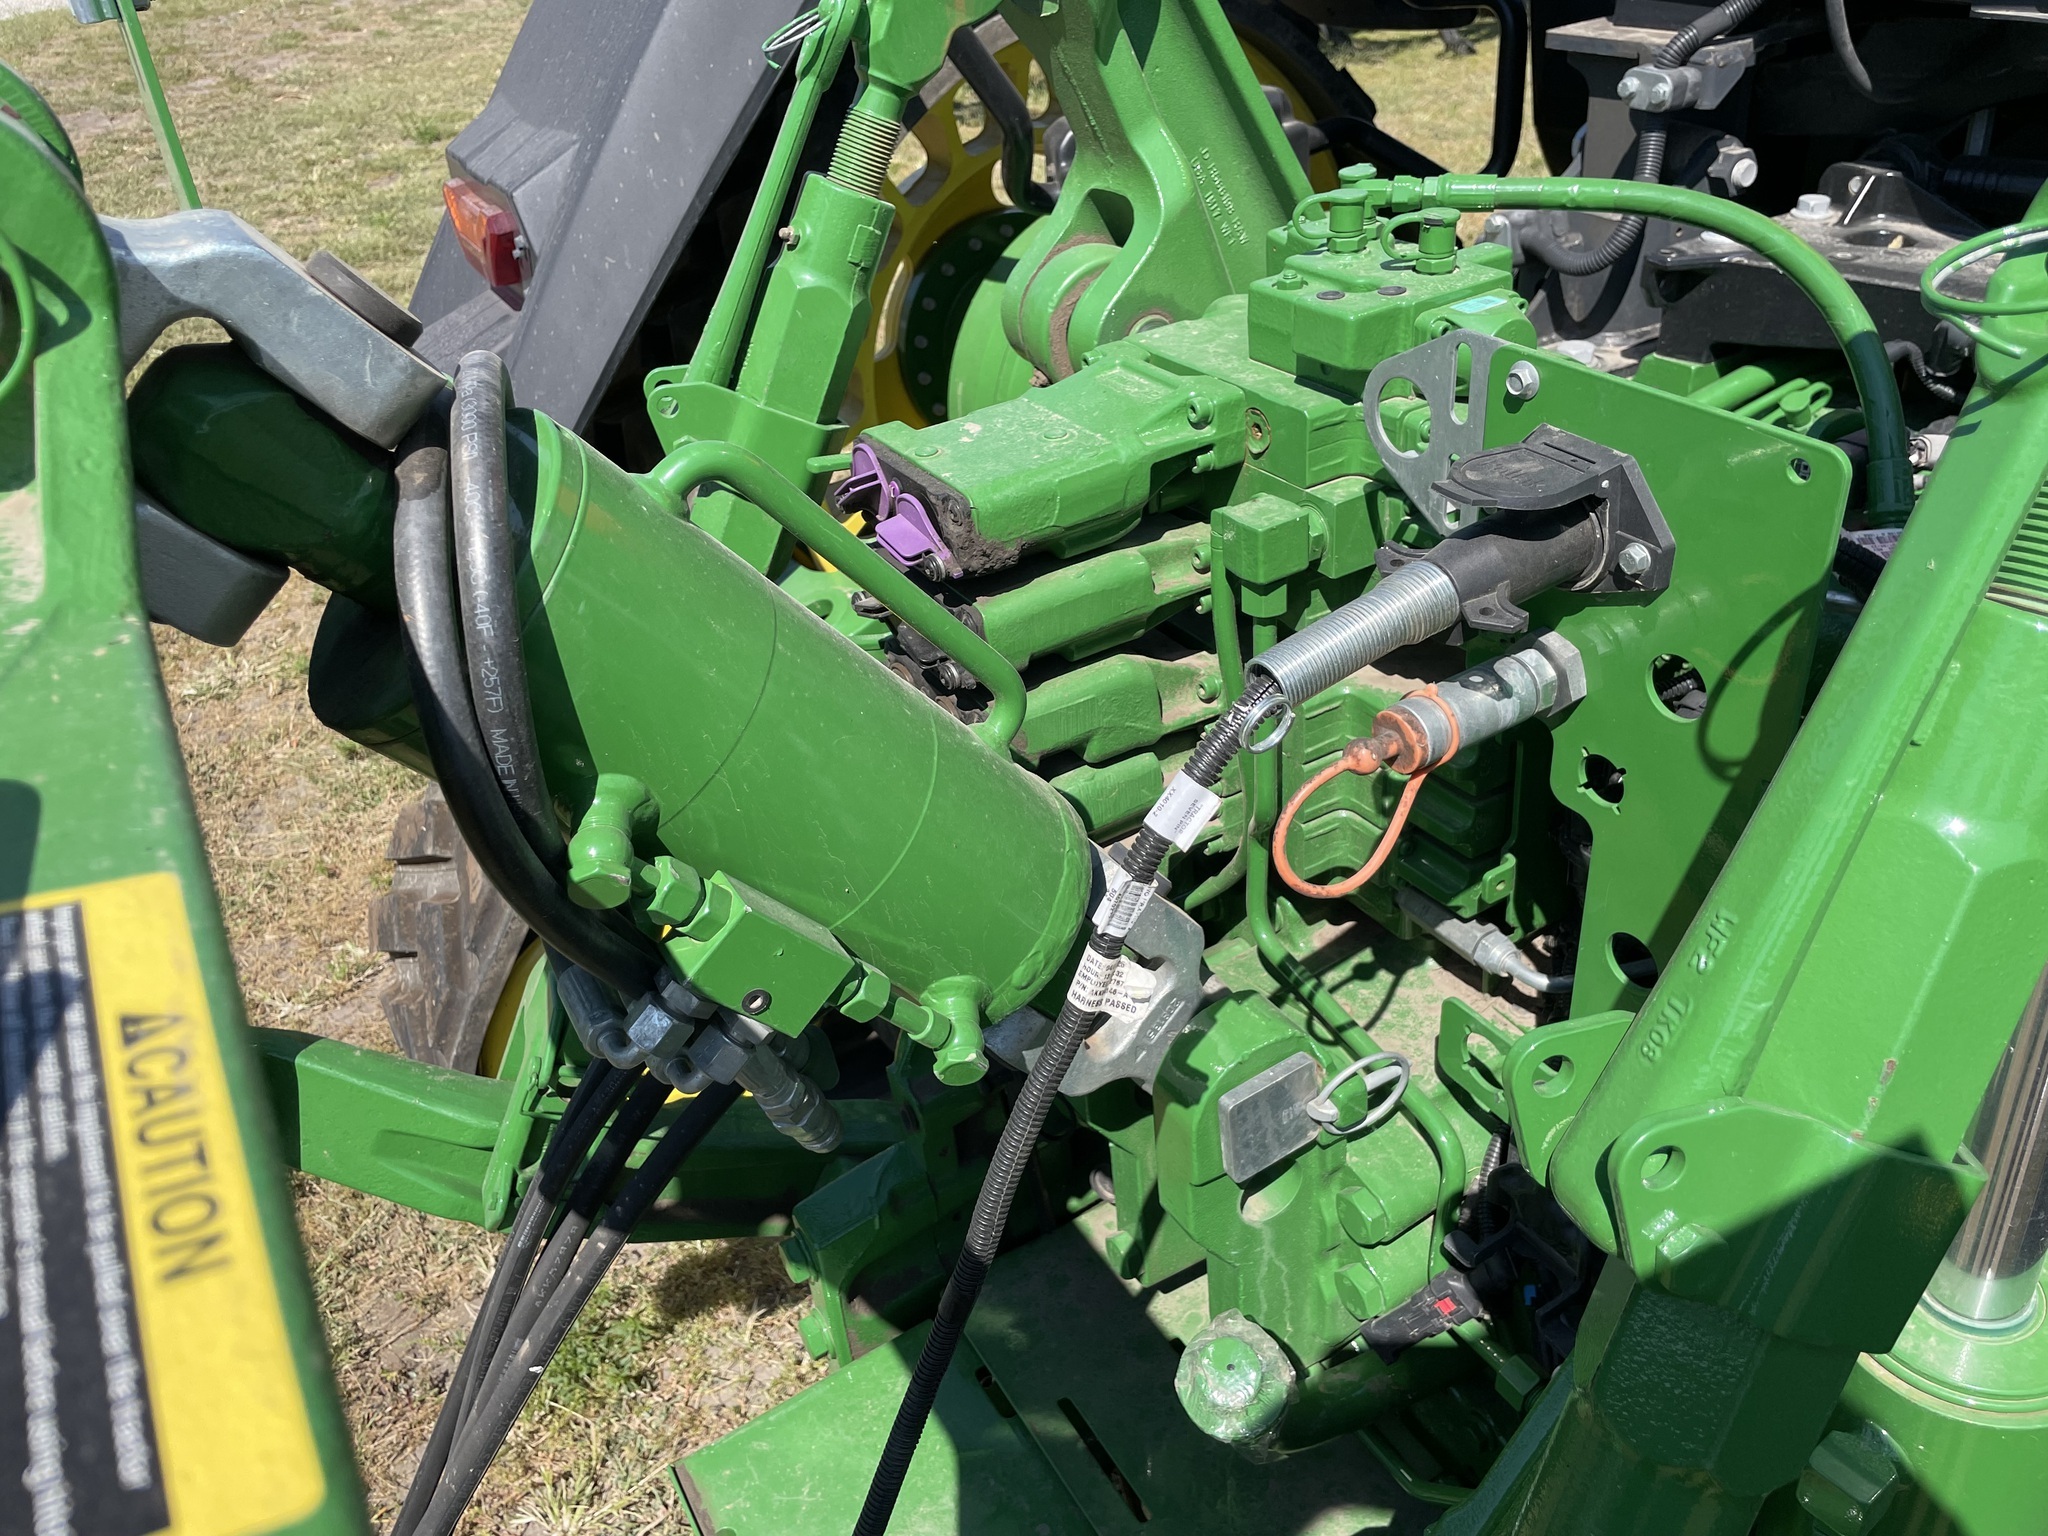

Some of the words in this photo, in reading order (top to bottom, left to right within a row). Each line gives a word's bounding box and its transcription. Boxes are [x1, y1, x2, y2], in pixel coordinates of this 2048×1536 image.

[490, 727, 516, 777] MADE
[1105, 998, 1137, 1013] PASSED
[126, 1040, 236, 1284] CAUTION
